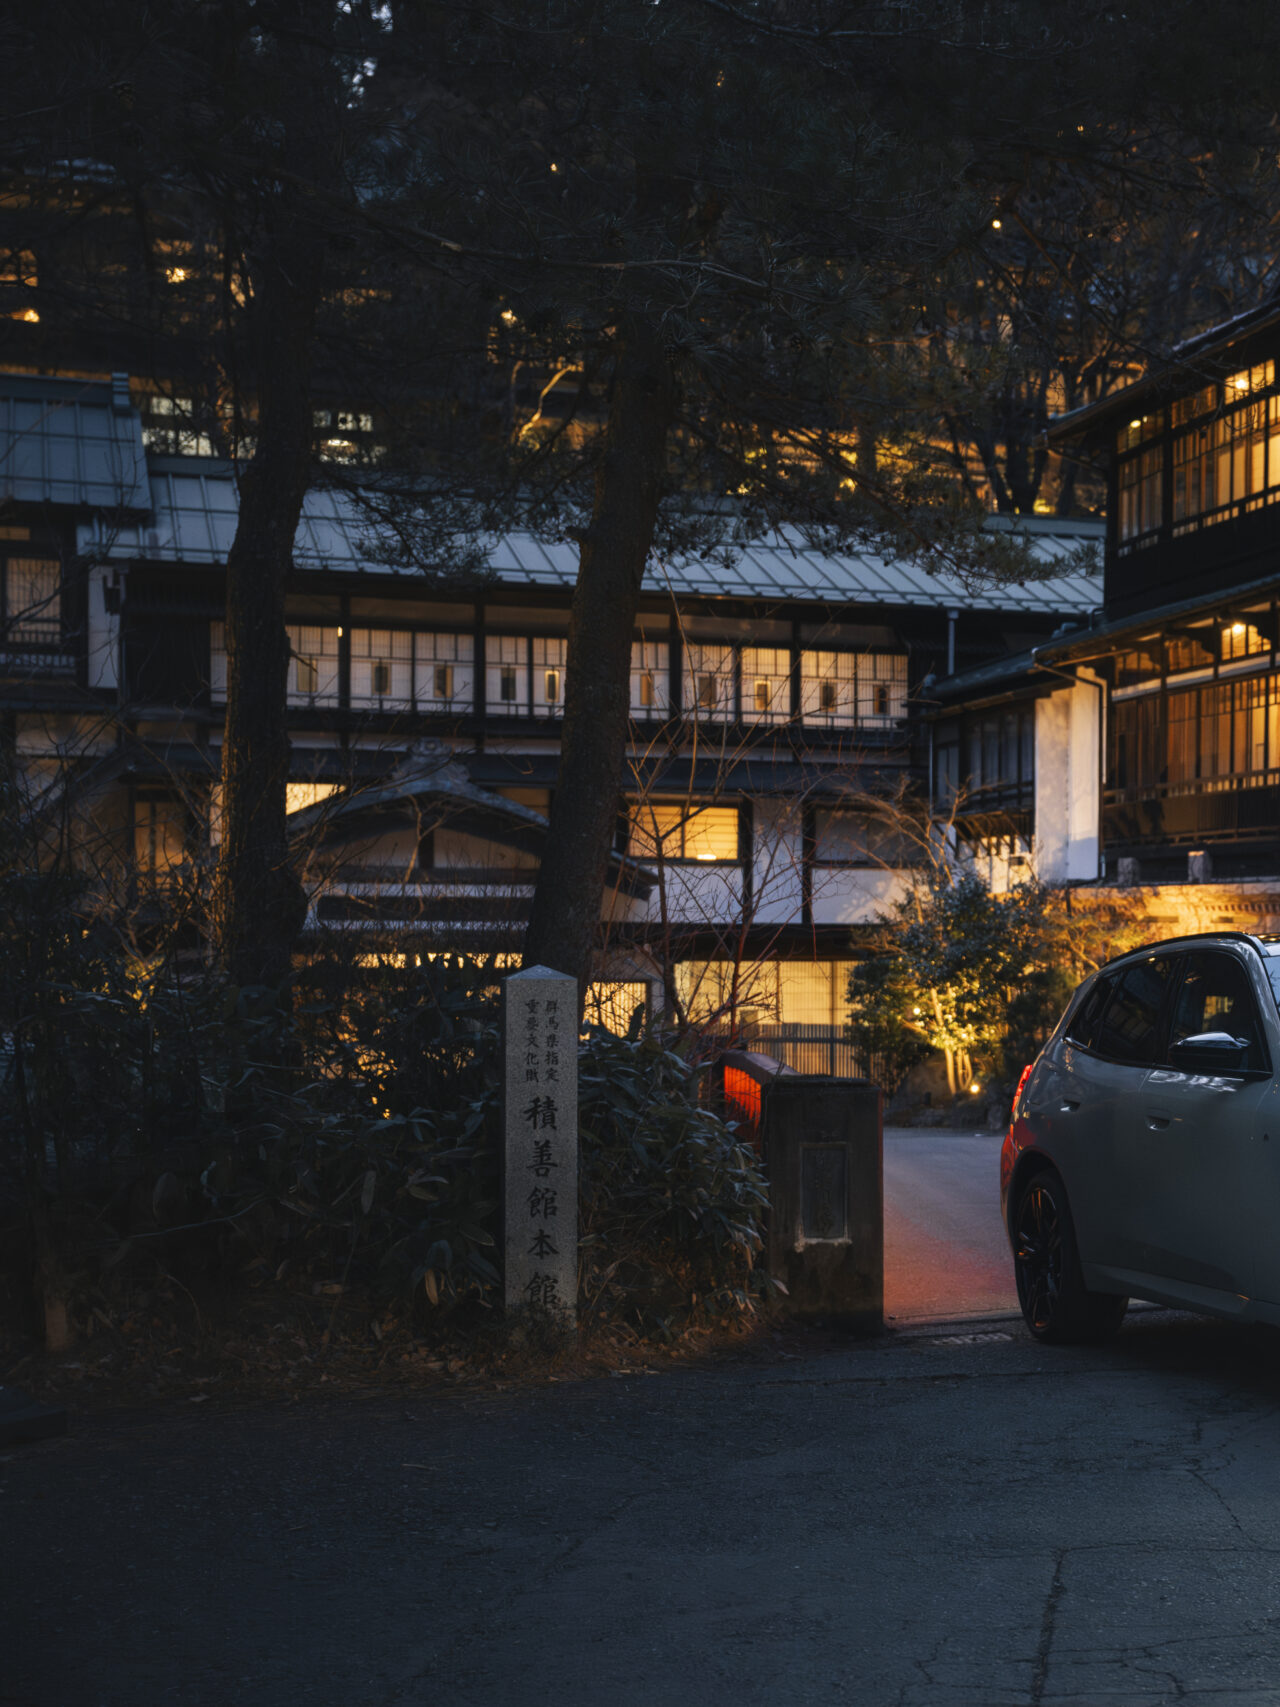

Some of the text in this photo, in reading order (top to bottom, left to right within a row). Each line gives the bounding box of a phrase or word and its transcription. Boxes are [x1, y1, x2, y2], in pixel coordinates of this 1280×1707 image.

[523, 1095, 560, 1306] 積善館本館
